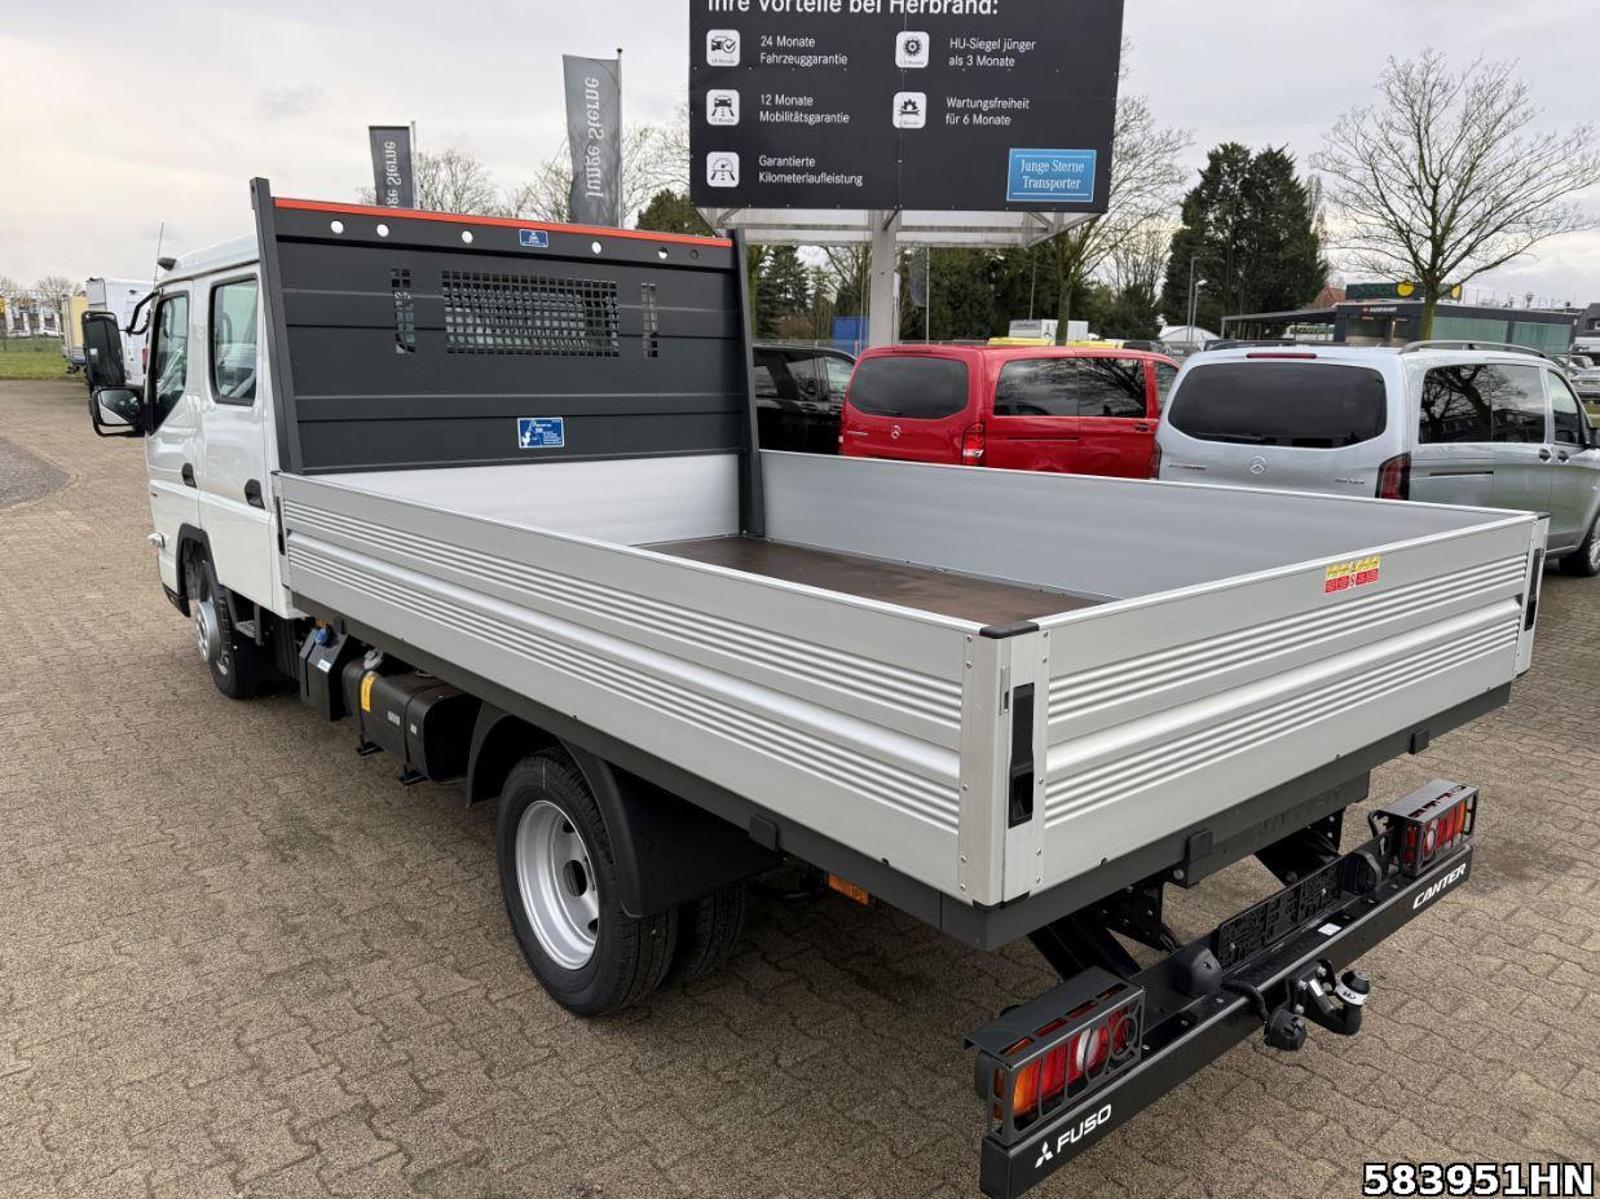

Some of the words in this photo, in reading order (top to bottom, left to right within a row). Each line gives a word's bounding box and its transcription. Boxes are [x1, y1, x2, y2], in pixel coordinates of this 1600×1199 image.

[708, 0, 750, 12] Ihre
[758, 0, 842, 13] Vorteile
[849, 0, 881, 13] bei
[889, 0, 999, 15] Herbrand:
[760, 35, 773, 47] 24
[776, 35, 816, 47] Monate
[950, 38, 1000, 52] HU-Siegel
[1002, 38, 1036, 53] jünger
[760, 52, 848, 67] Fahrzeuggarantie
[949, 55, 963, 66] als
[966, 55, 974, 66] 3
[976, 55, 1015, 67] Monate
[761, 94, 772, 105] 12
[775, 94, 814, 106] Monate
[946, 97, 1030, 110] Wartungsfreiheit
[759, 110, 850, 125] Mobilitätsgarantie
[945, 114, 959, 125] für
[962, 114, 970, 125] 6
[972, 114, 1012, 125] Monate
[758, 155, 816, 167] Garantierte
[1020, 159, 1050, 175] Junge
[1052, 159, 1085, 173] Sterne
[758, 171, 864, 187] Kilometerlaufleistung
[1022, 175, 1082, 191] Transporter
[1413, 862, 1467, 909] CANTER
[1056, 1103, 1112, 1154] FUSO
